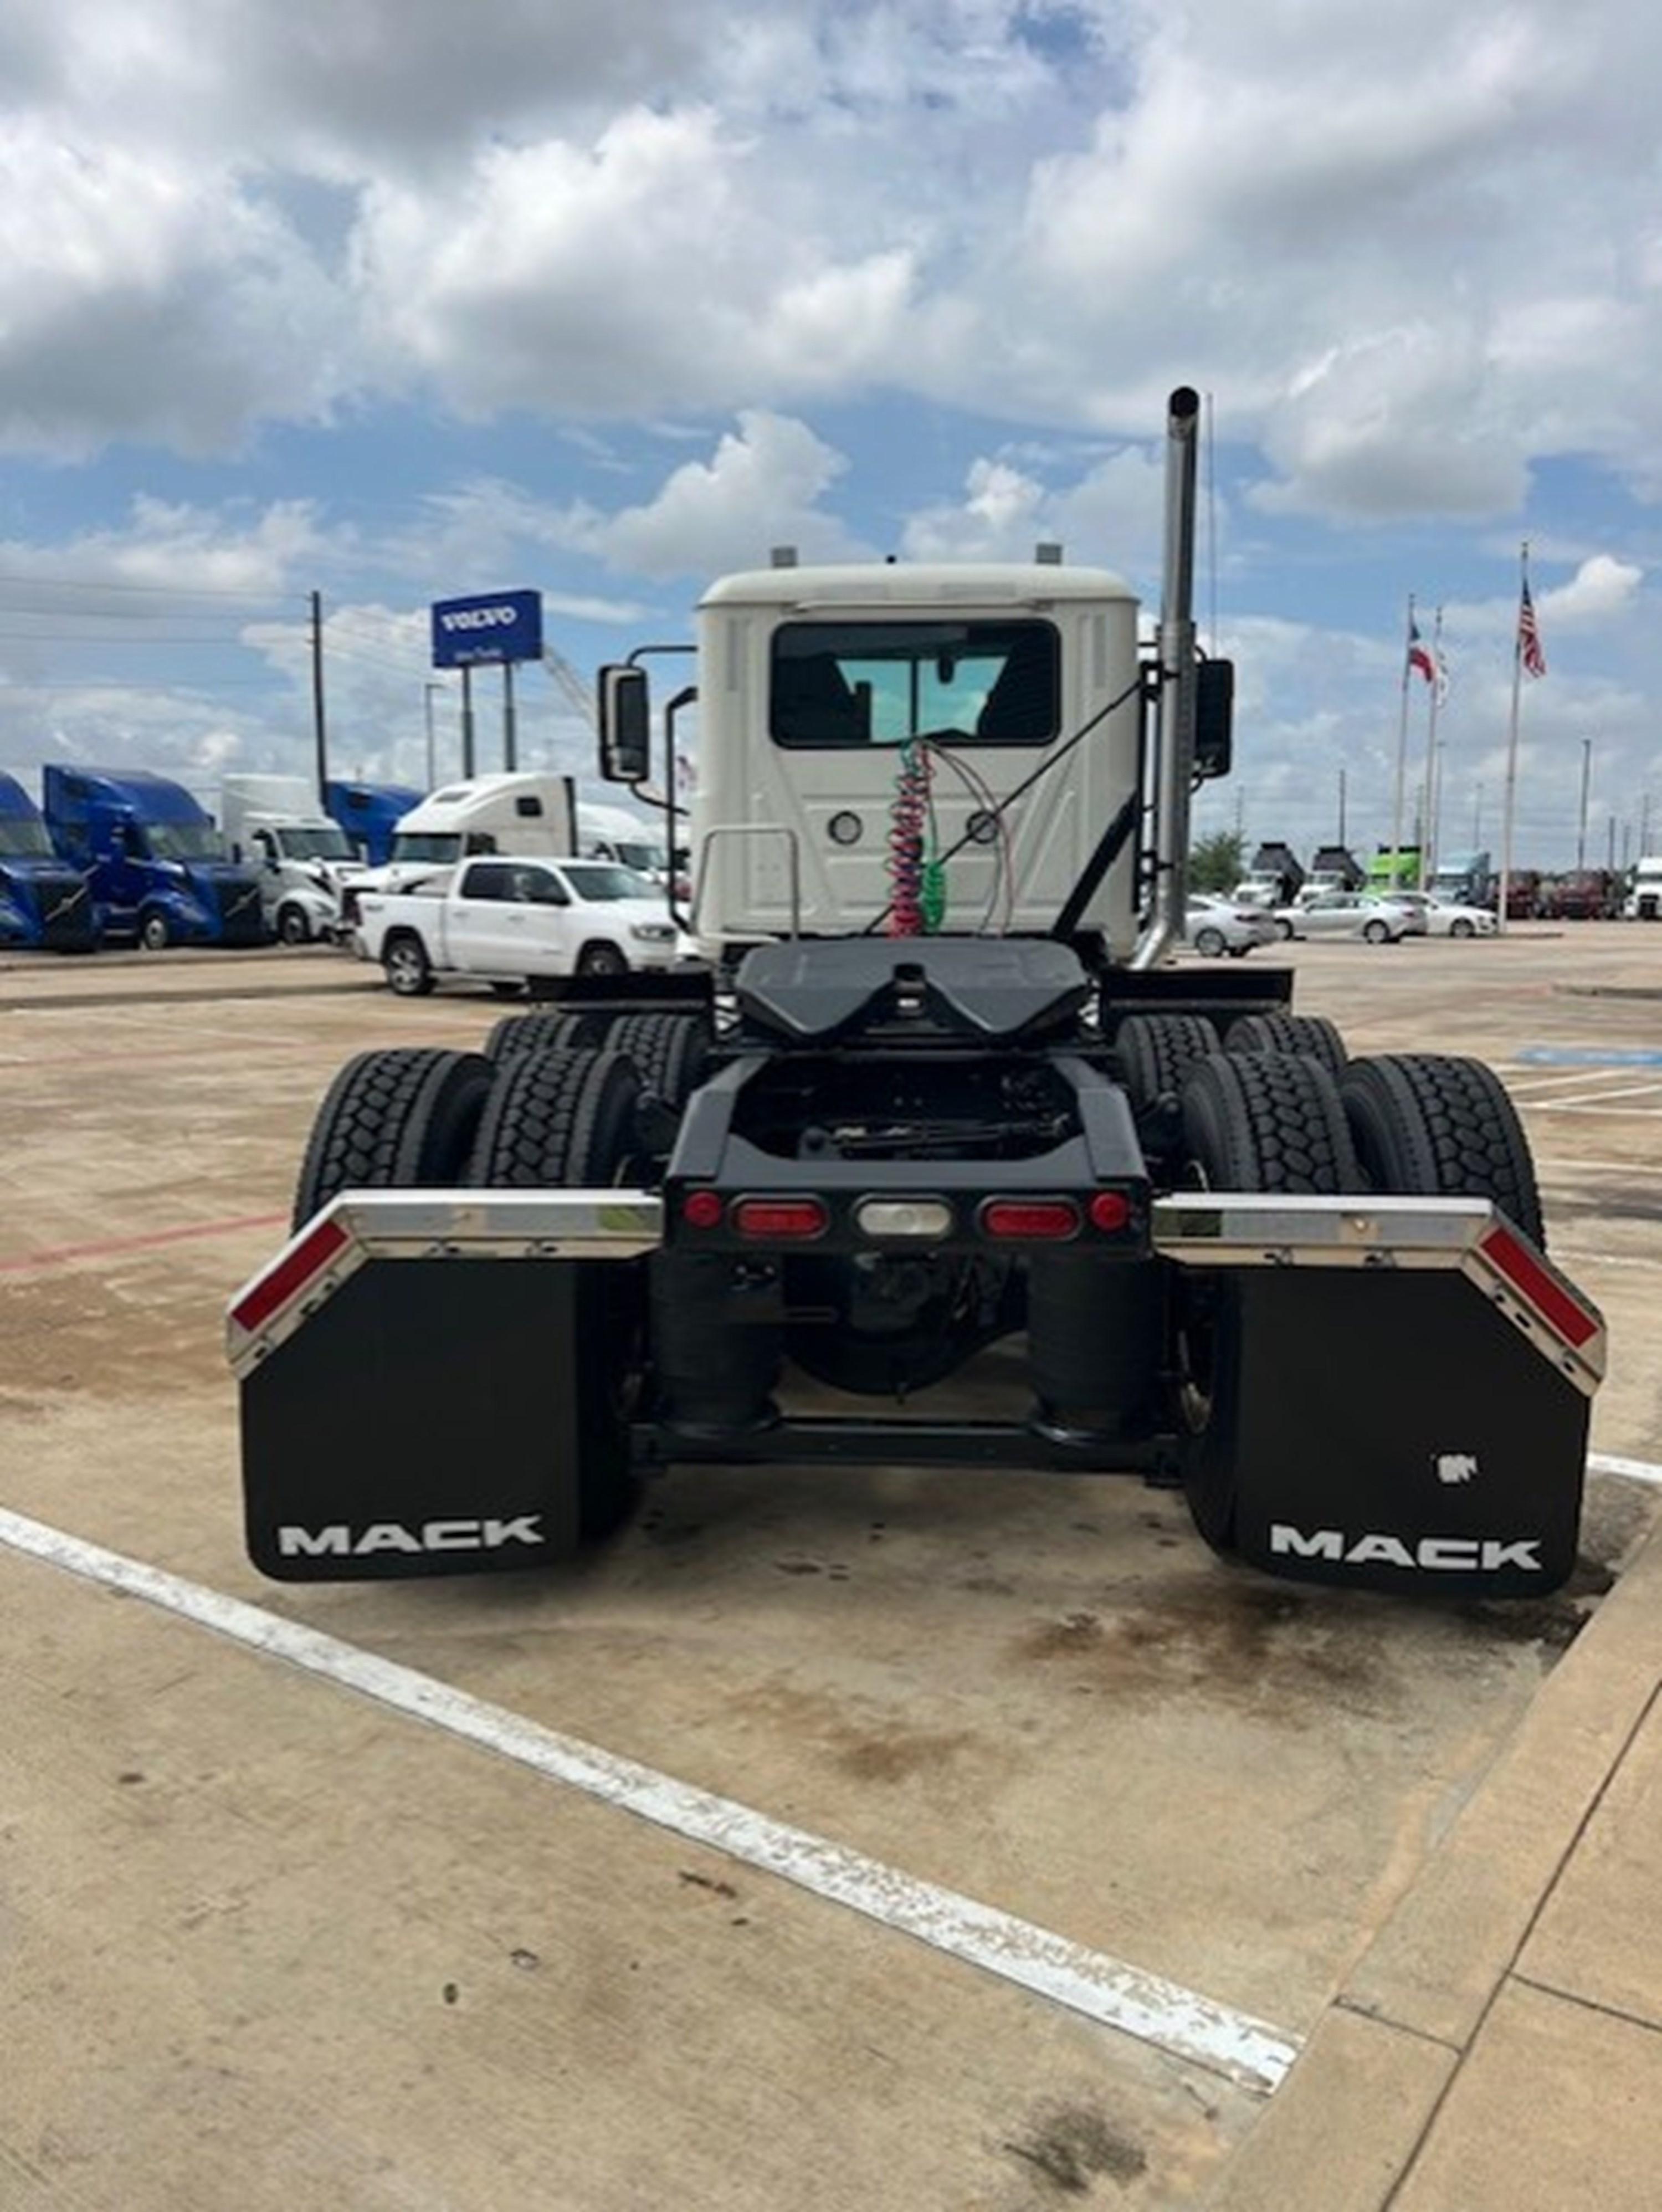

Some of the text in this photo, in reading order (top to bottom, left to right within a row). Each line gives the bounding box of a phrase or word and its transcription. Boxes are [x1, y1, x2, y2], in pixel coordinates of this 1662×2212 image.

[442, 606, 517, 631] VOLVO
[279, 1515, 544, 1555] MACK
[1270, 1524, 1541, 1570] MACK
